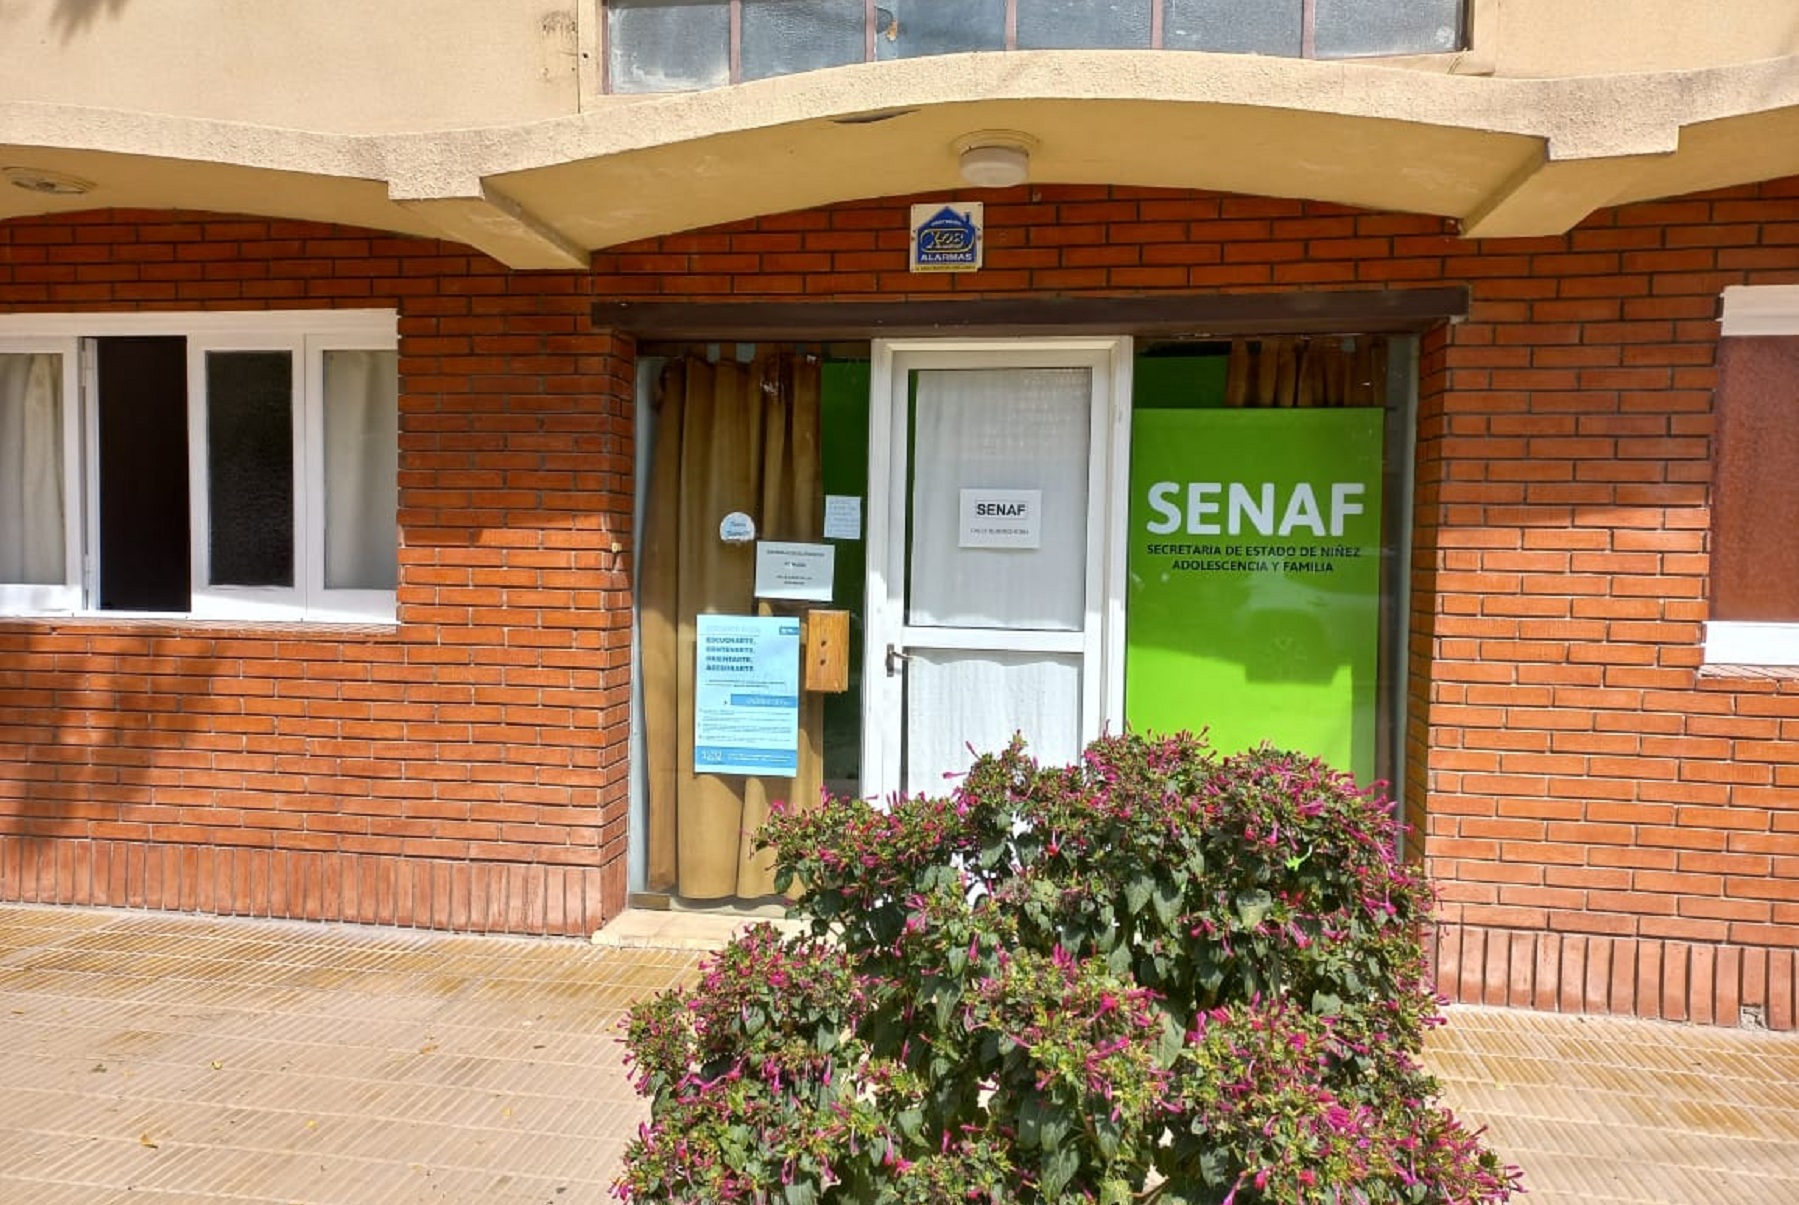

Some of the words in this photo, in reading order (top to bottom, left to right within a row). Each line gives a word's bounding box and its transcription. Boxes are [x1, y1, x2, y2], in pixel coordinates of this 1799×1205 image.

[920, 253, 972, 261] ALARMAS
[976, 503, 1026, 516] SENAF
[1146, 481, 1365, 537] SENAF
[1147, 544, 1221, 556] SECRETARIA
[1225, 545, 1242, 556] DE
[1246, 545, 1296, 557] ESTADO
[1299, 546, 1317, 557] DE
[1320, 544, 1361, 558] NIÑEZ
[1172, 560, 1269, 572] ADOLESCENCIA
[1271, 561, 1280, 572] Y
[1283, 561, 1334, 573] FAMILIA
